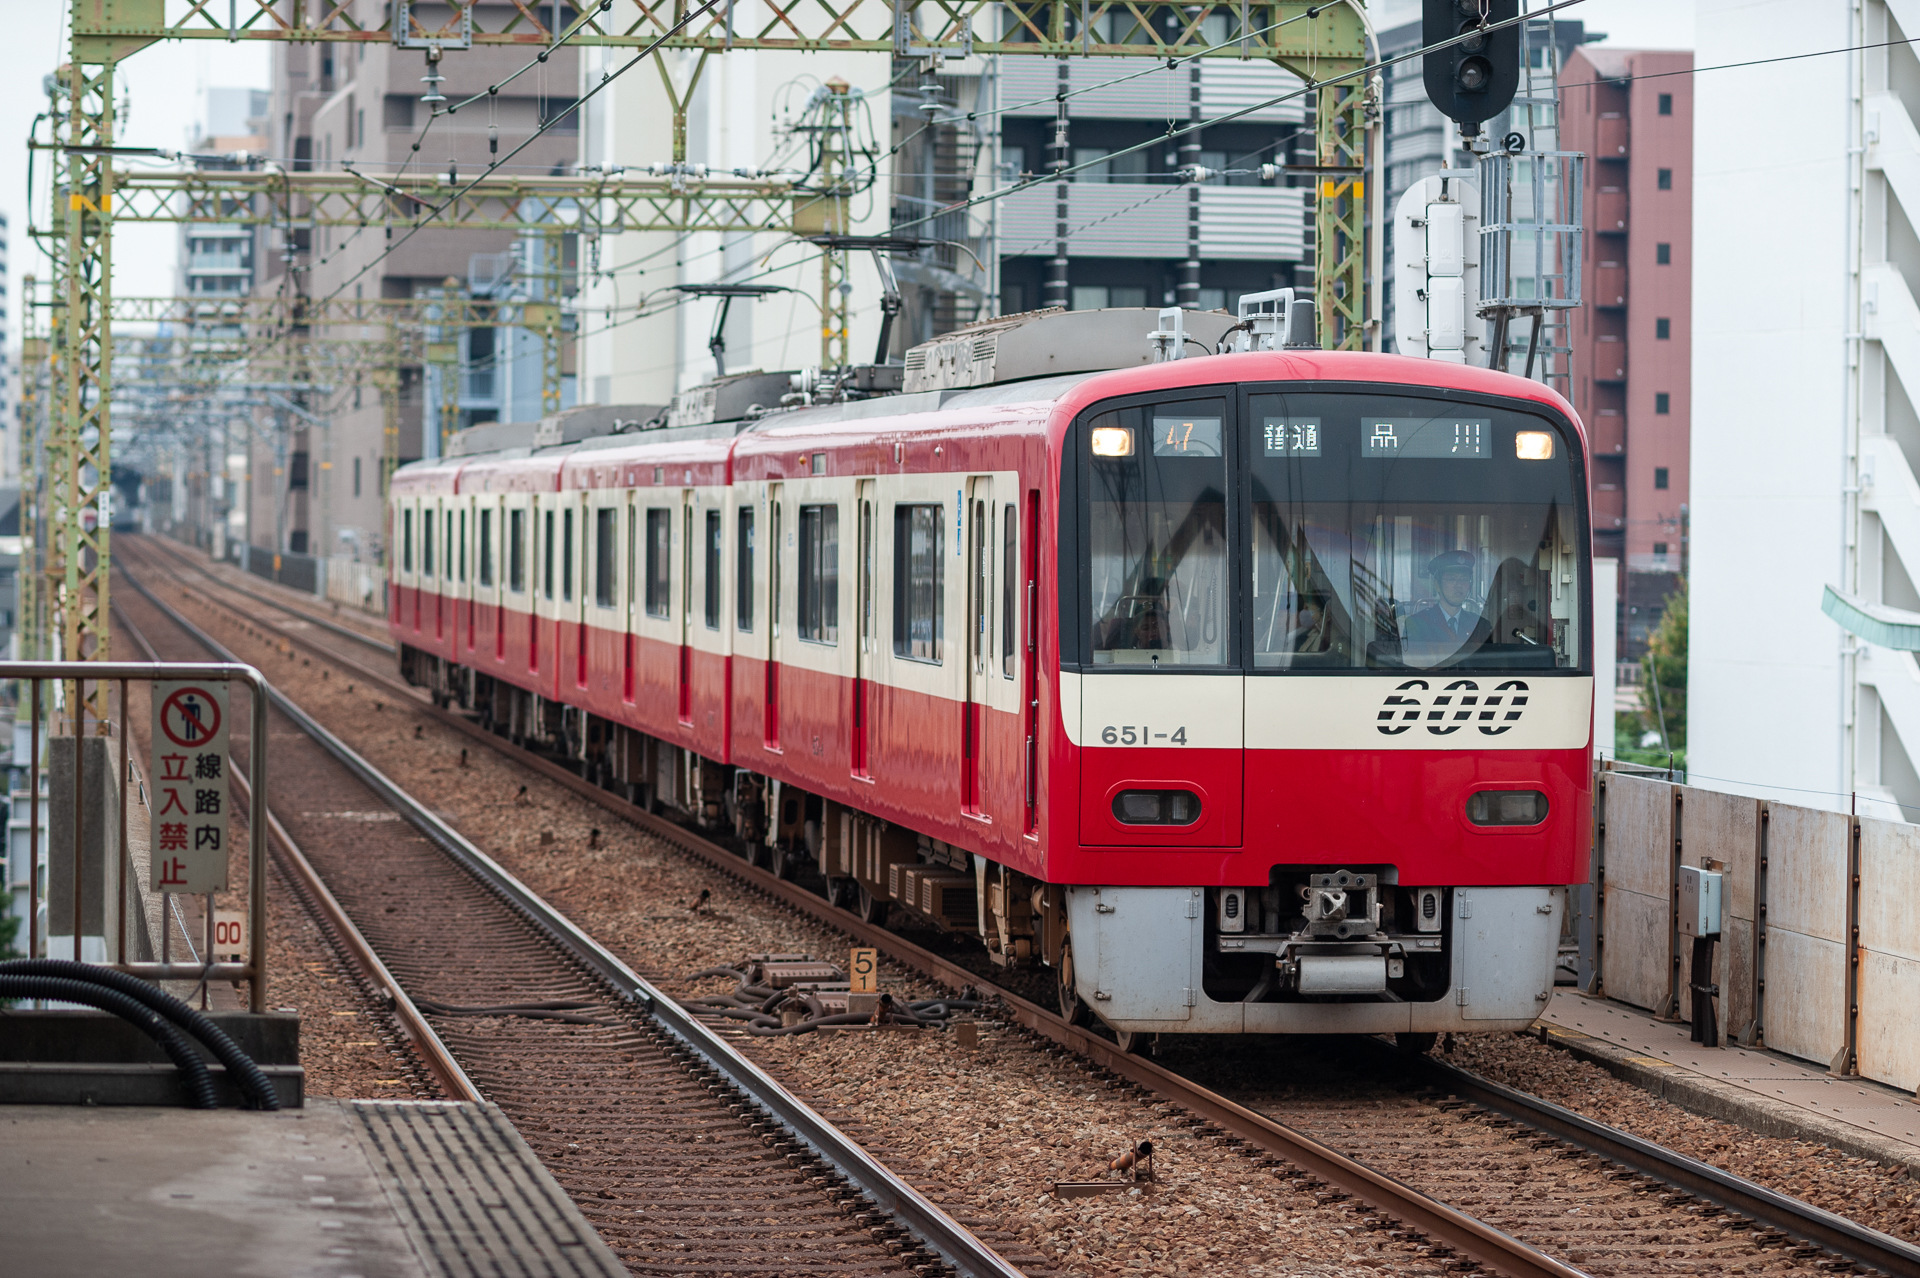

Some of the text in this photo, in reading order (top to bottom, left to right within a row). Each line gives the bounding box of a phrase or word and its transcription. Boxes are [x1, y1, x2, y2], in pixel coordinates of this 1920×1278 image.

[1509, 135, 1521, 151] 2
[1166, 422, 1194, 451] 47
[1264, 424, 1318, 450] 普通
[1376, 679, 1529, 735] 600
[1101, 725, 1187, 746] 651-4
[195, 753, 221, 850] 線路内
[159, 753, 188, 885] 立入禁止
[855, 951, 873, 974] 5
[859, 975, 866, 990] 1
